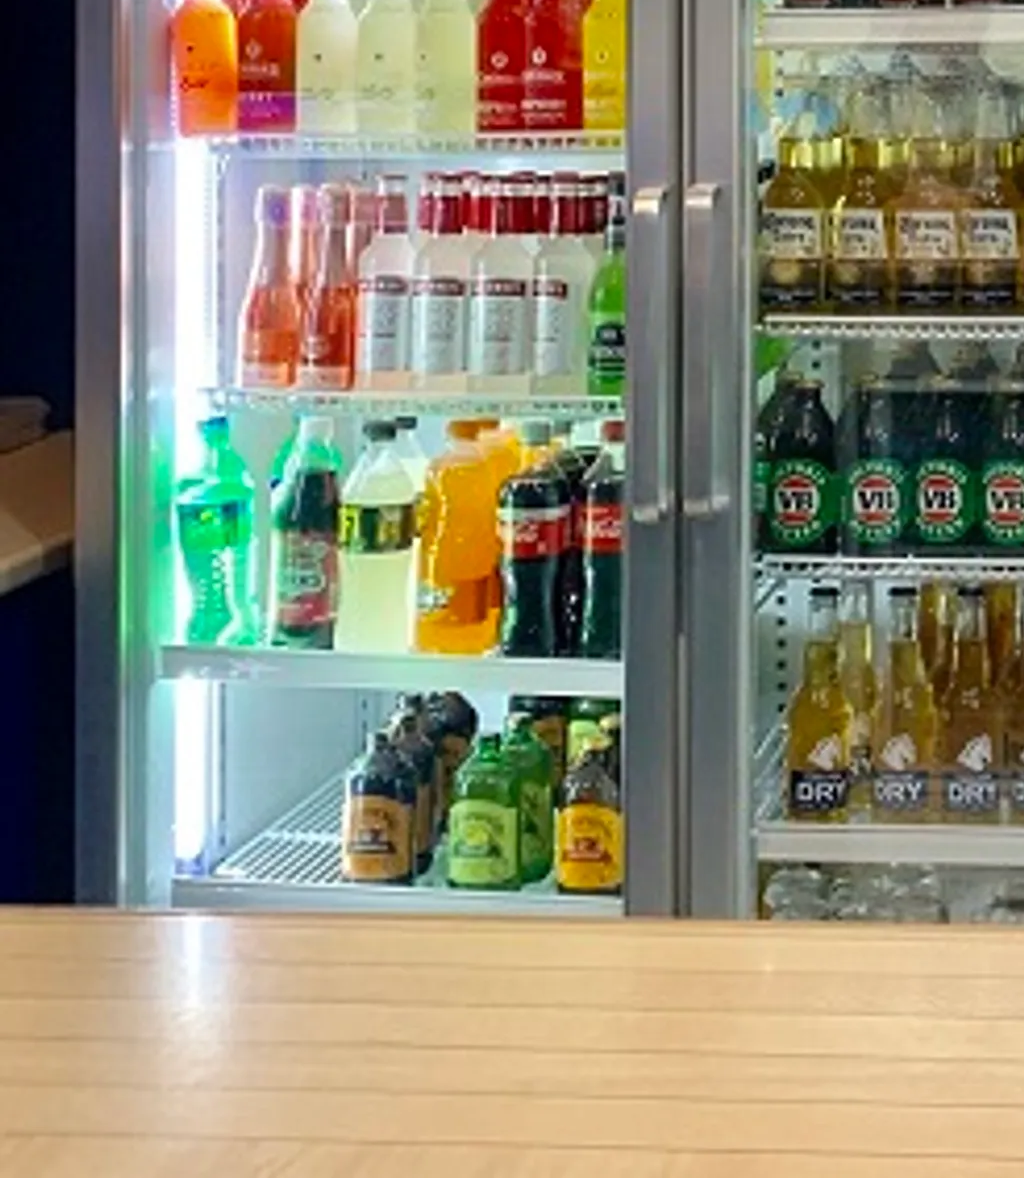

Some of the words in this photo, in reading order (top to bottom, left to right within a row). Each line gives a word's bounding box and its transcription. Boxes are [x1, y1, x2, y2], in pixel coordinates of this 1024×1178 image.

[777, 490, 815, 510] VB
[858, 490, 895, 510] VB
[924, 490, 957, 509] VB
[797, 781, 846, 802] DRY
[873, 781, 923, 802] DRY
[948, 782, 998, 804] DRY
